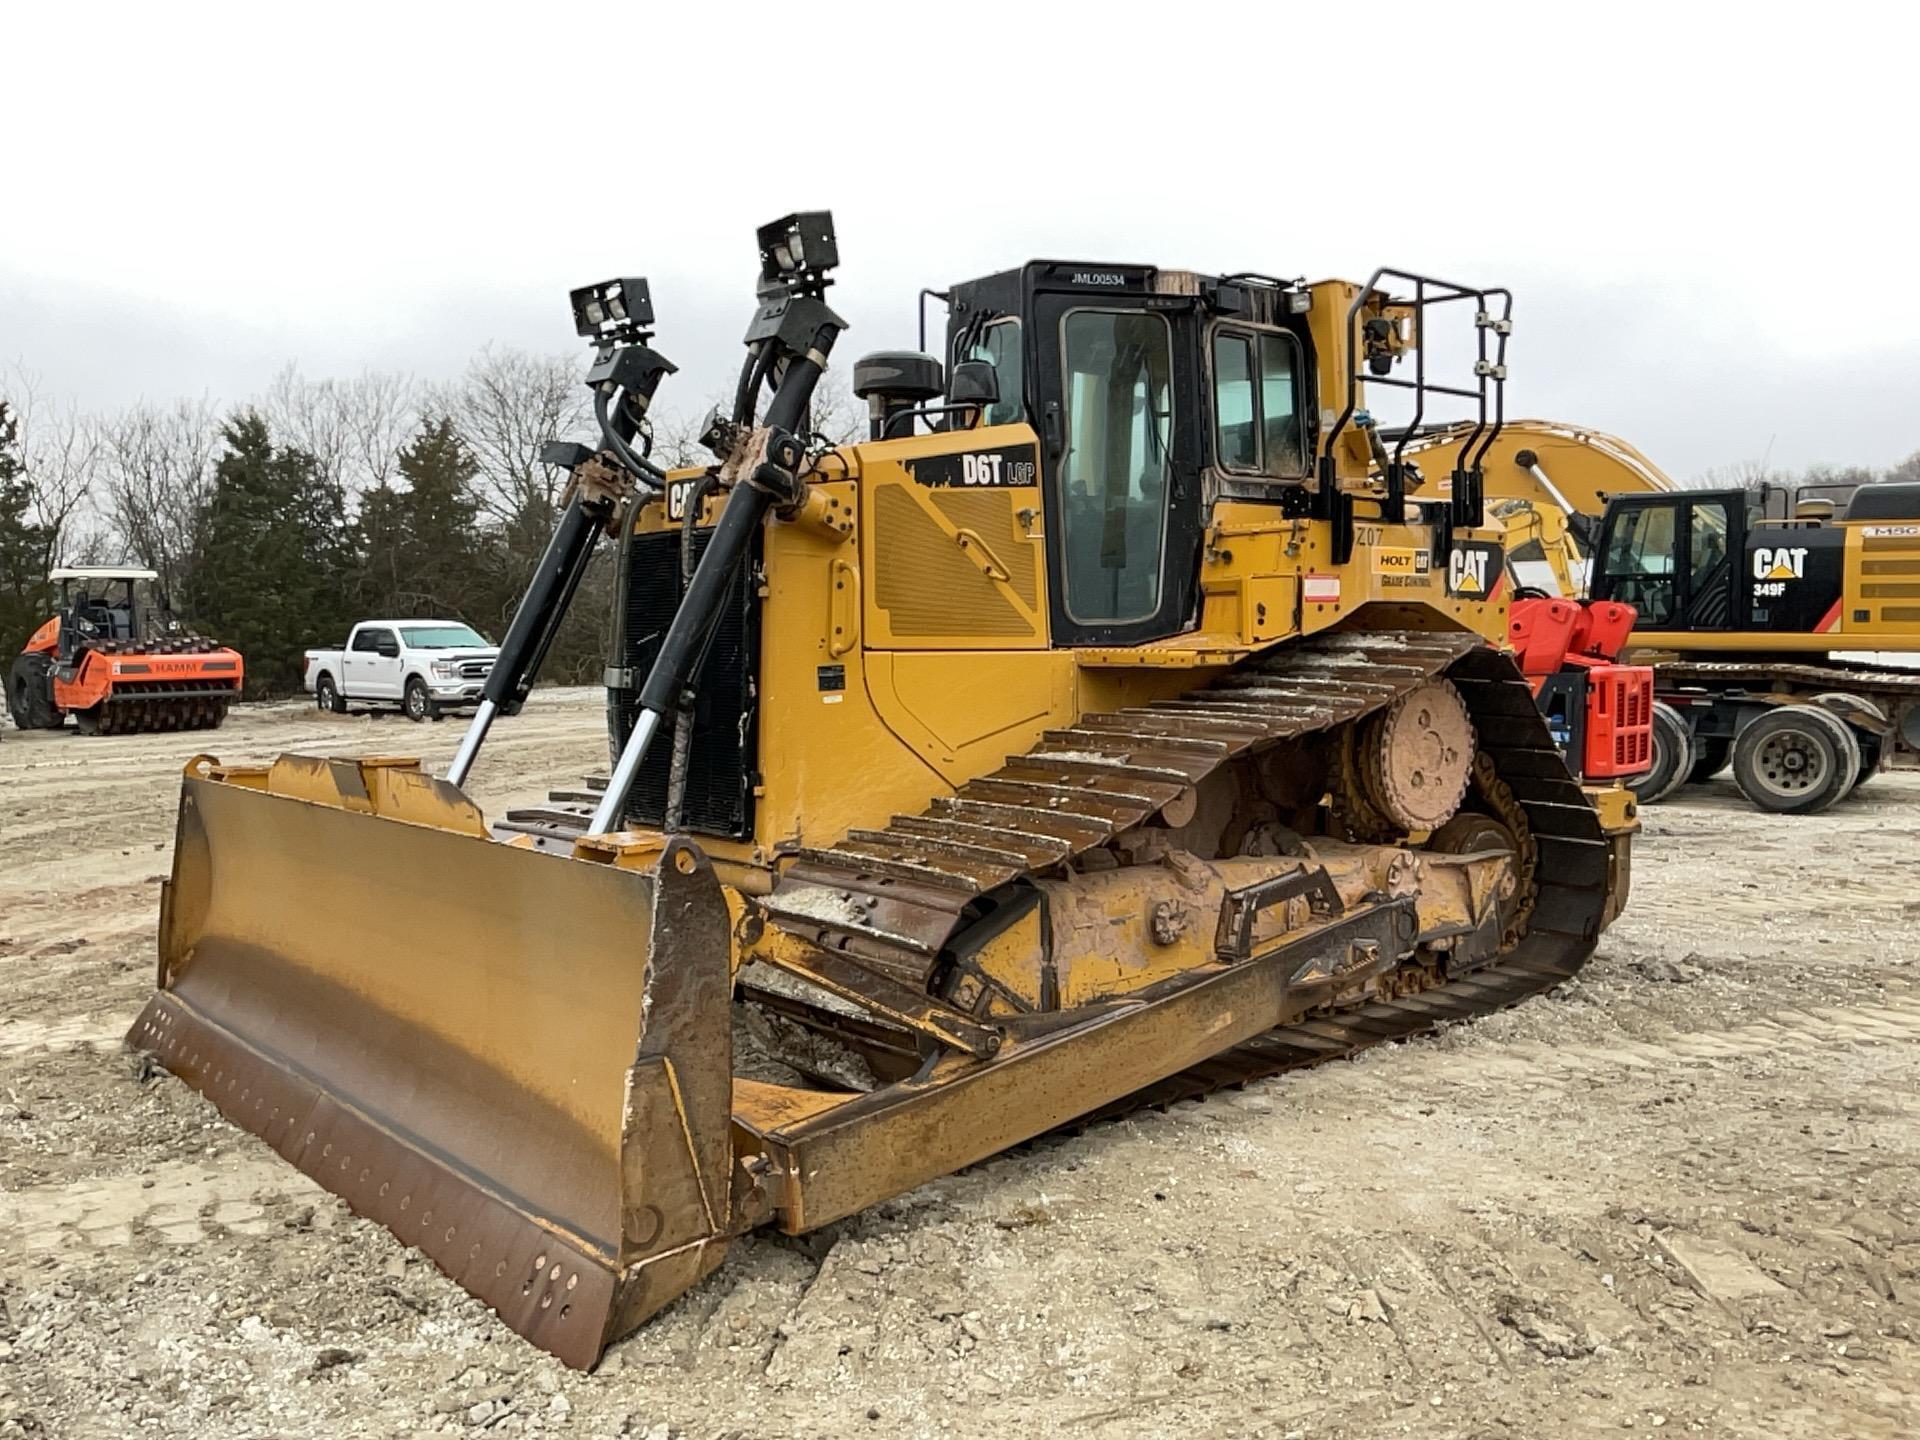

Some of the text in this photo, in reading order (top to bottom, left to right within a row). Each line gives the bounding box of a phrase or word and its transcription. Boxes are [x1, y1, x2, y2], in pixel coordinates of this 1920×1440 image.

[962, 454, 1035, 485] D6T LGP
[1380, 555, 1412, 566] HOLT
[1450, 549, 1489, 593] CAT
[1753, 547, 1809, 580] CAT
[1753, 582, 1786, 597] 349F
[155, 663, 197, 673] HAMM
